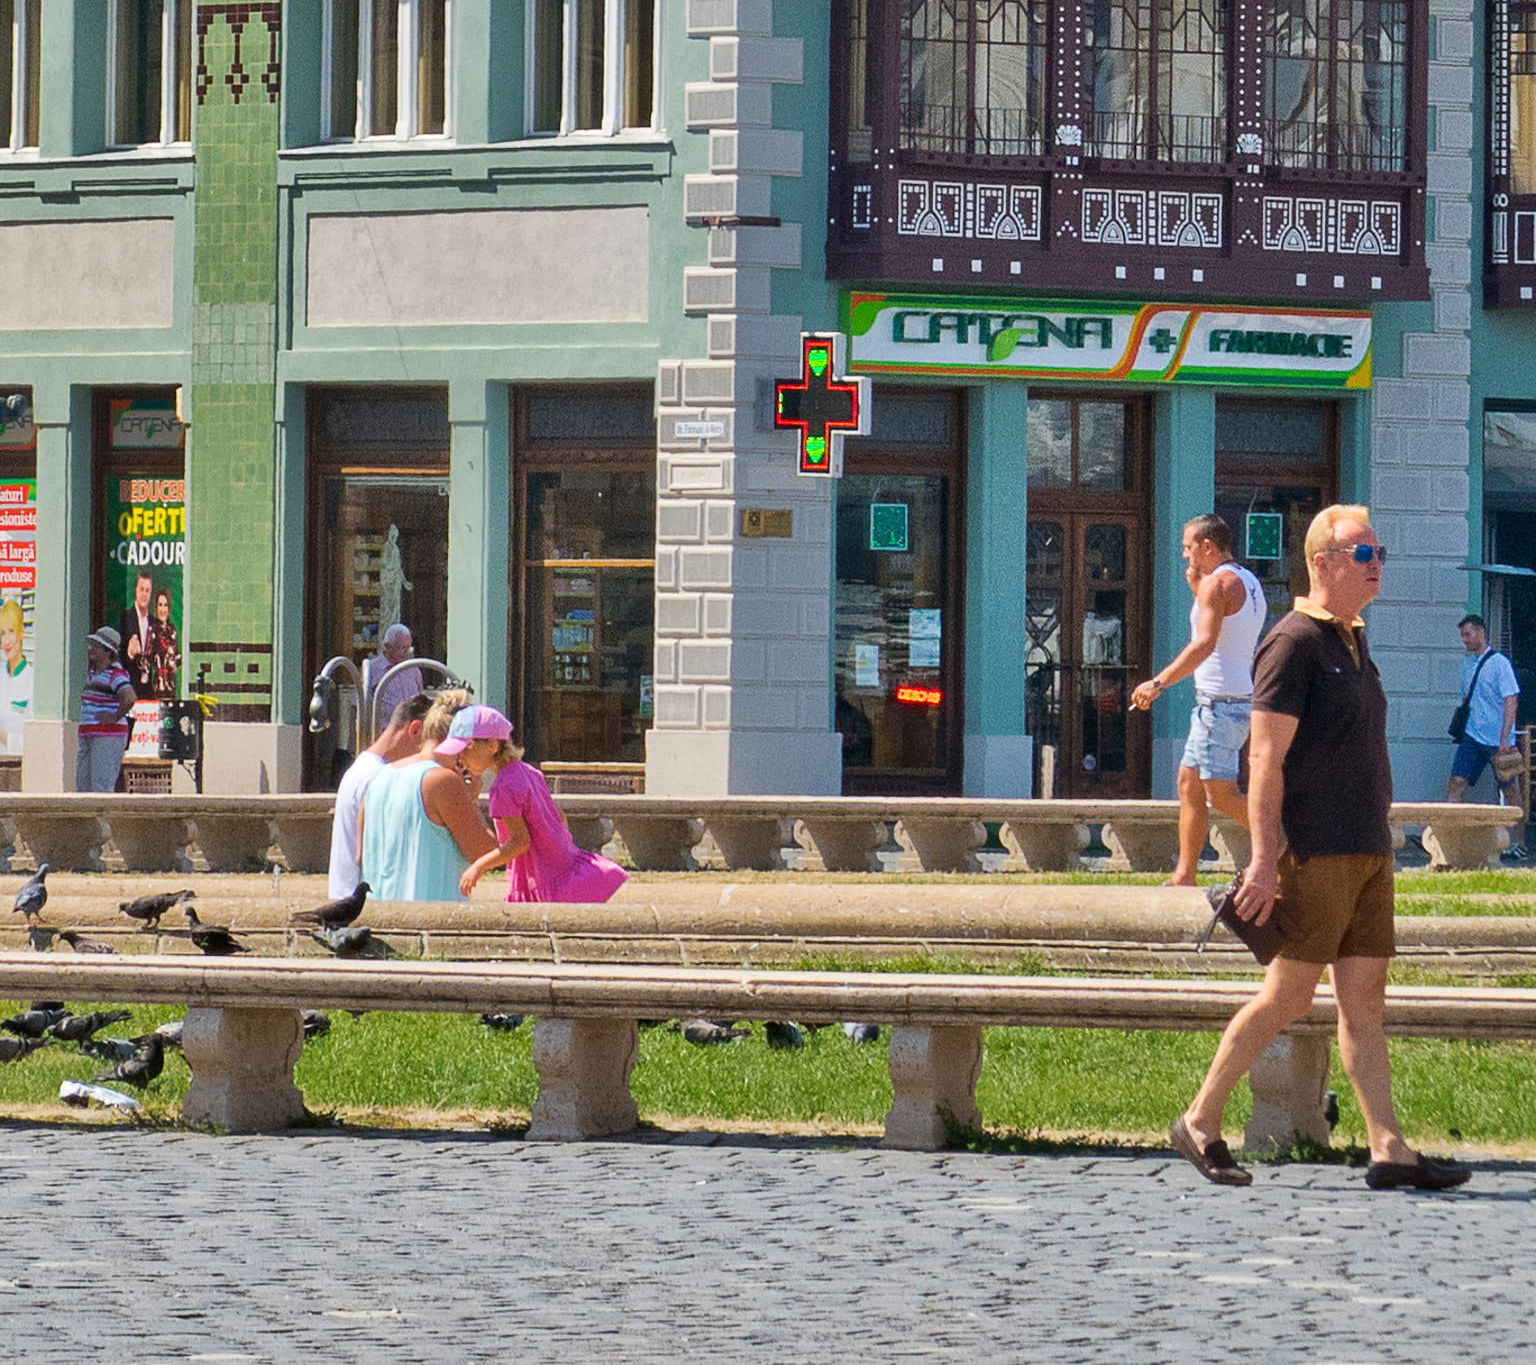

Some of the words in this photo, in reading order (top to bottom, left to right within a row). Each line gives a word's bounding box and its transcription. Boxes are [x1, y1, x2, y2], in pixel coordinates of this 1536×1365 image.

[892, 311, 1112, 354] CATENA
[1209, 329, 1352, 358] FARMACIE
[9, 544, 35, 562] largă
[898, 688, 941, 704] DESCHIS
